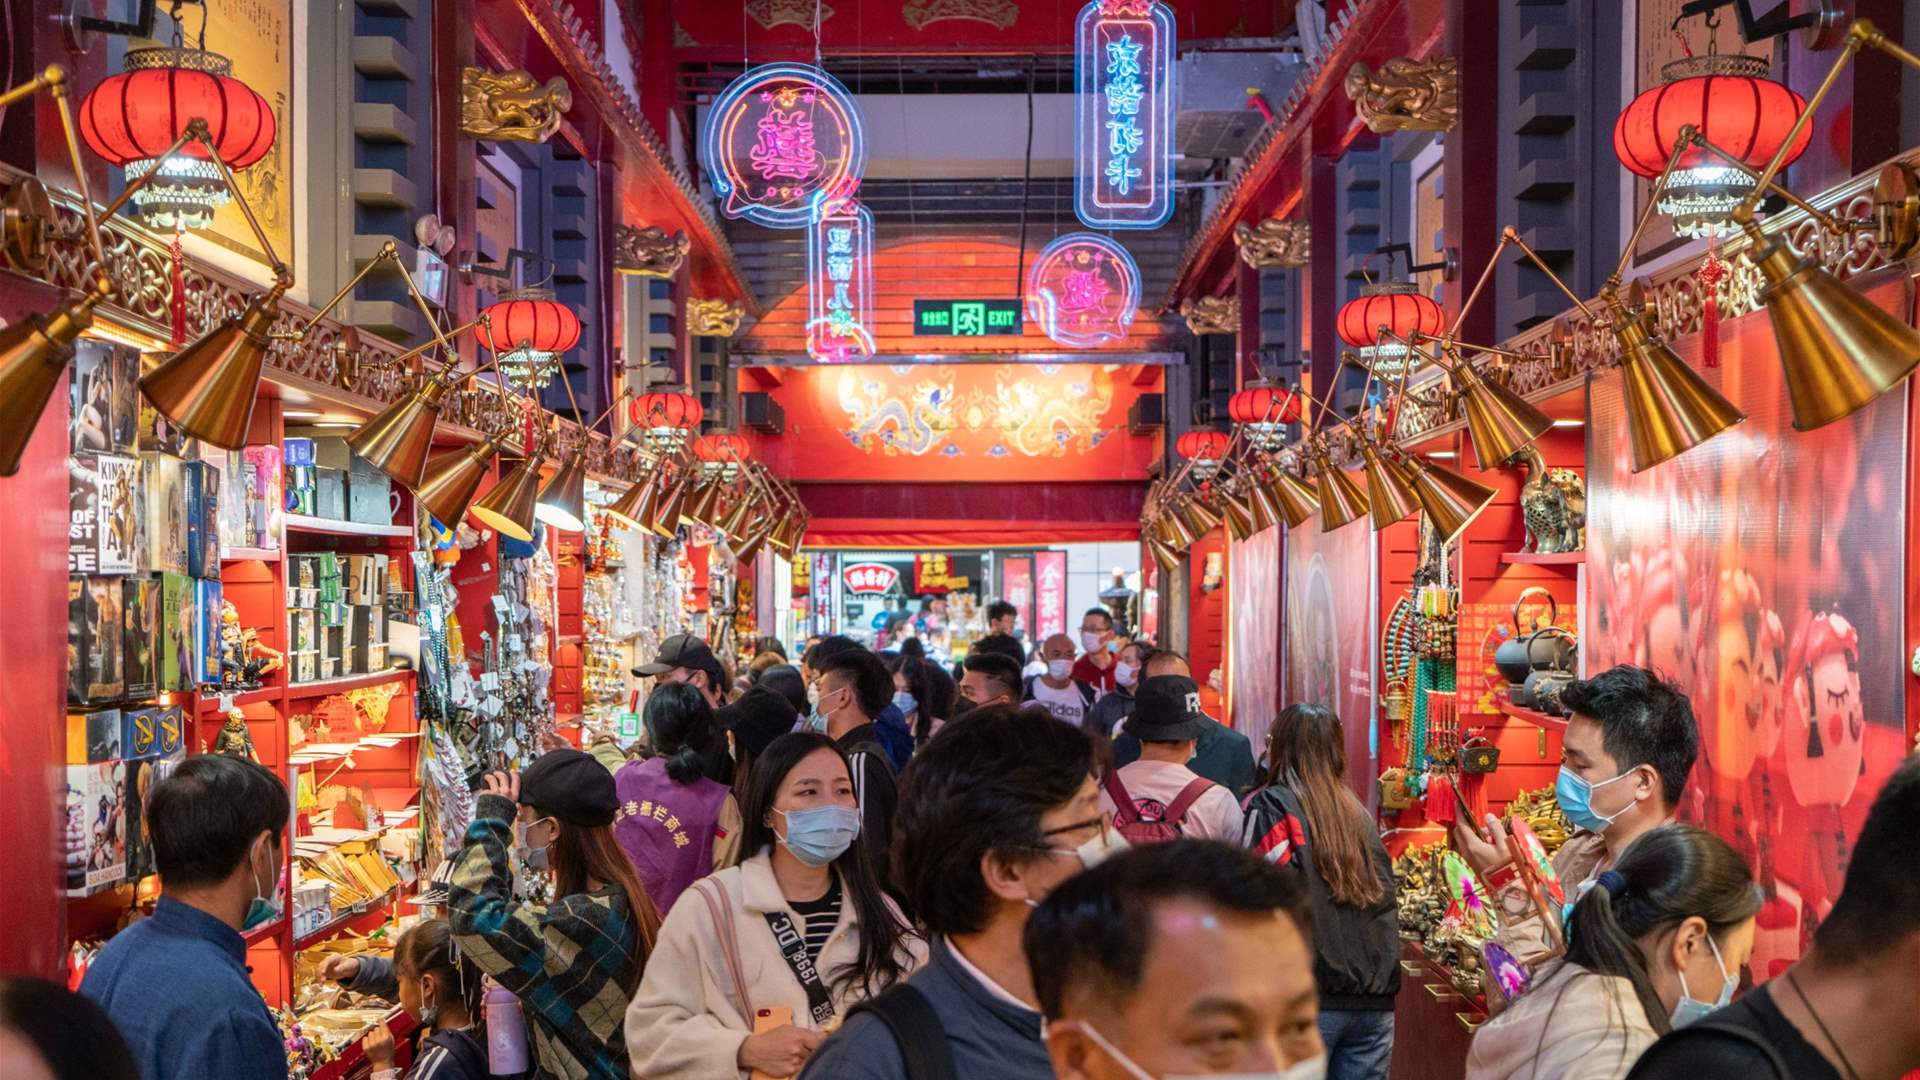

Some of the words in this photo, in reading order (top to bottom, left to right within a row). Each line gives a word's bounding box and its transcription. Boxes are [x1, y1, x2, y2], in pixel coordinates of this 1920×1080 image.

[988, 310, 1016, 326] EXIT
[72, 509, 95, 524] OF
[1185, 692, 1200, 712] R
